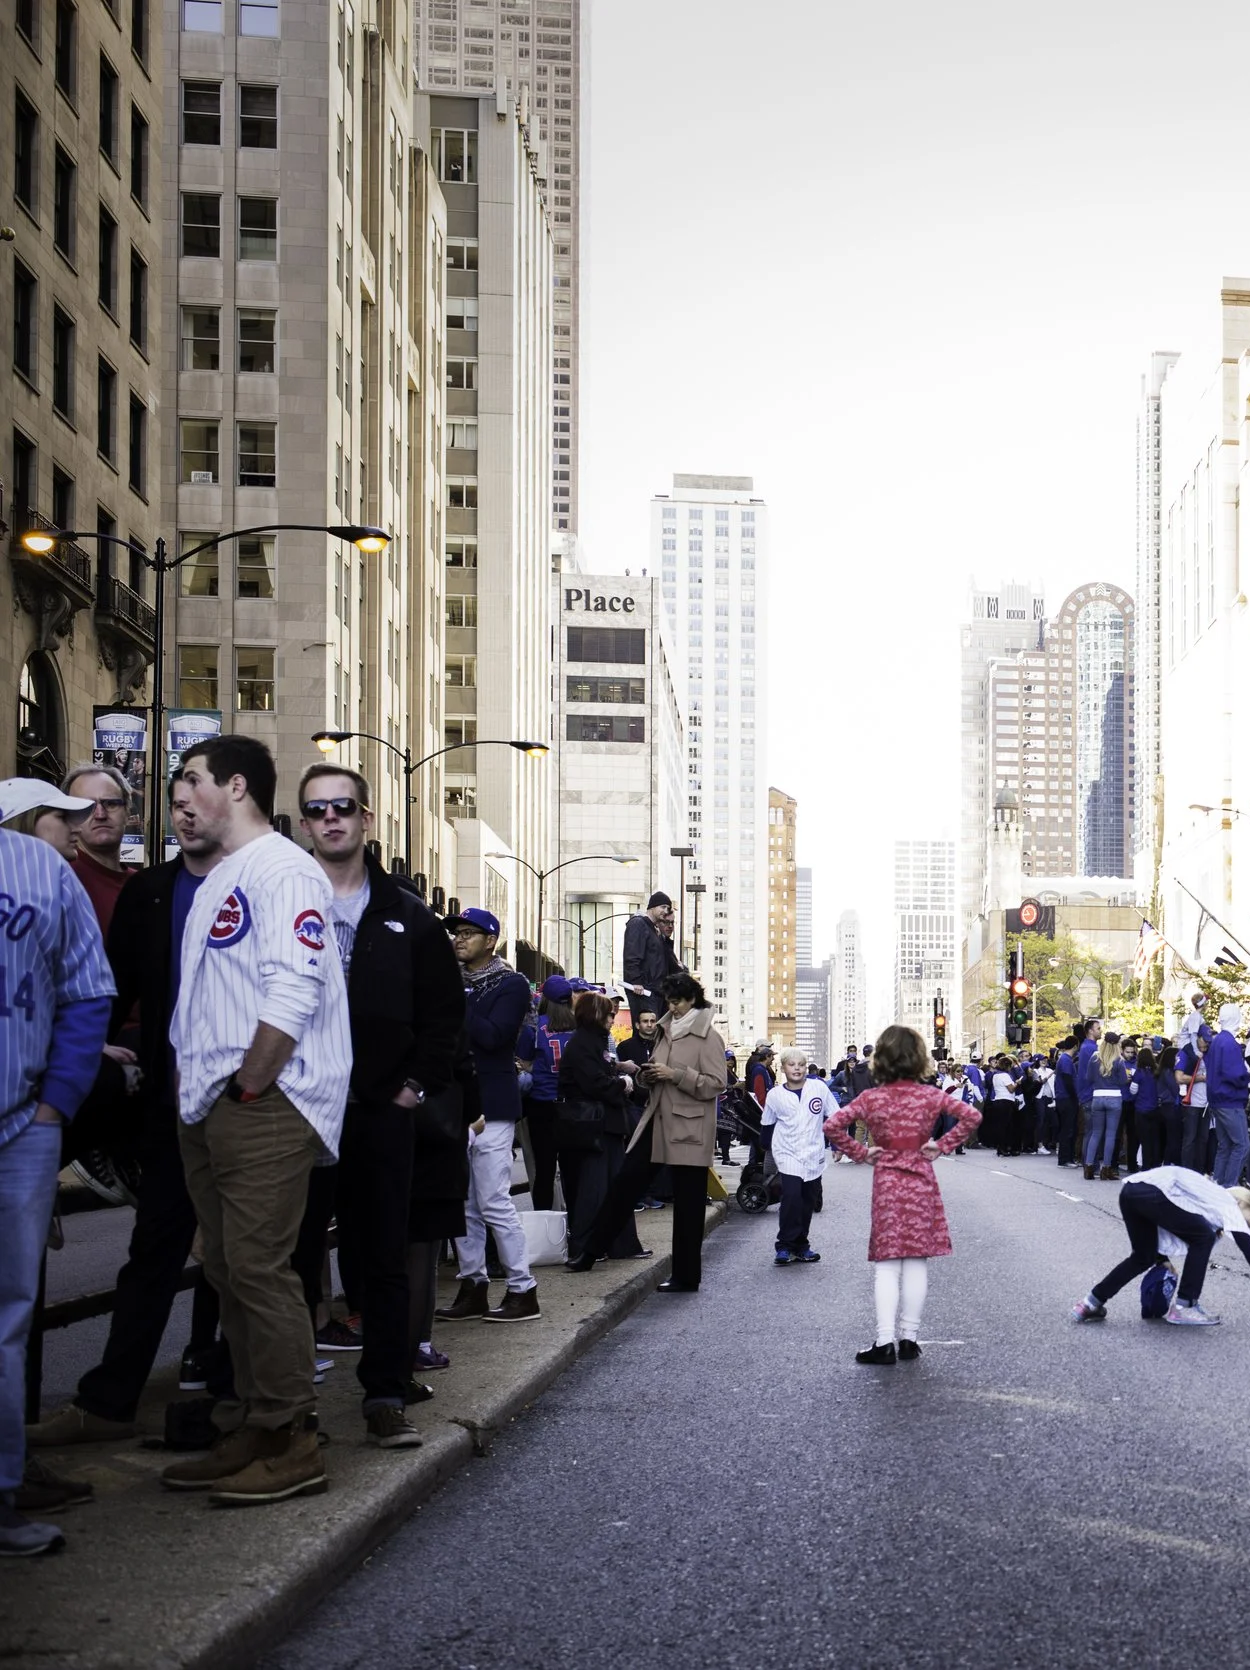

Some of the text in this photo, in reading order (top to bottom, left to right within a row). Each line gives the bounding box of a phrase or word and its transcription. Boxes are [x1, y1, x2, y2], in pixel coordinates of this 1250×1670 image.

[564, 588, 635, 613] Place
[102, 734, 137, 744] RUGBY
[177, 736, 208, 744] RUGB
